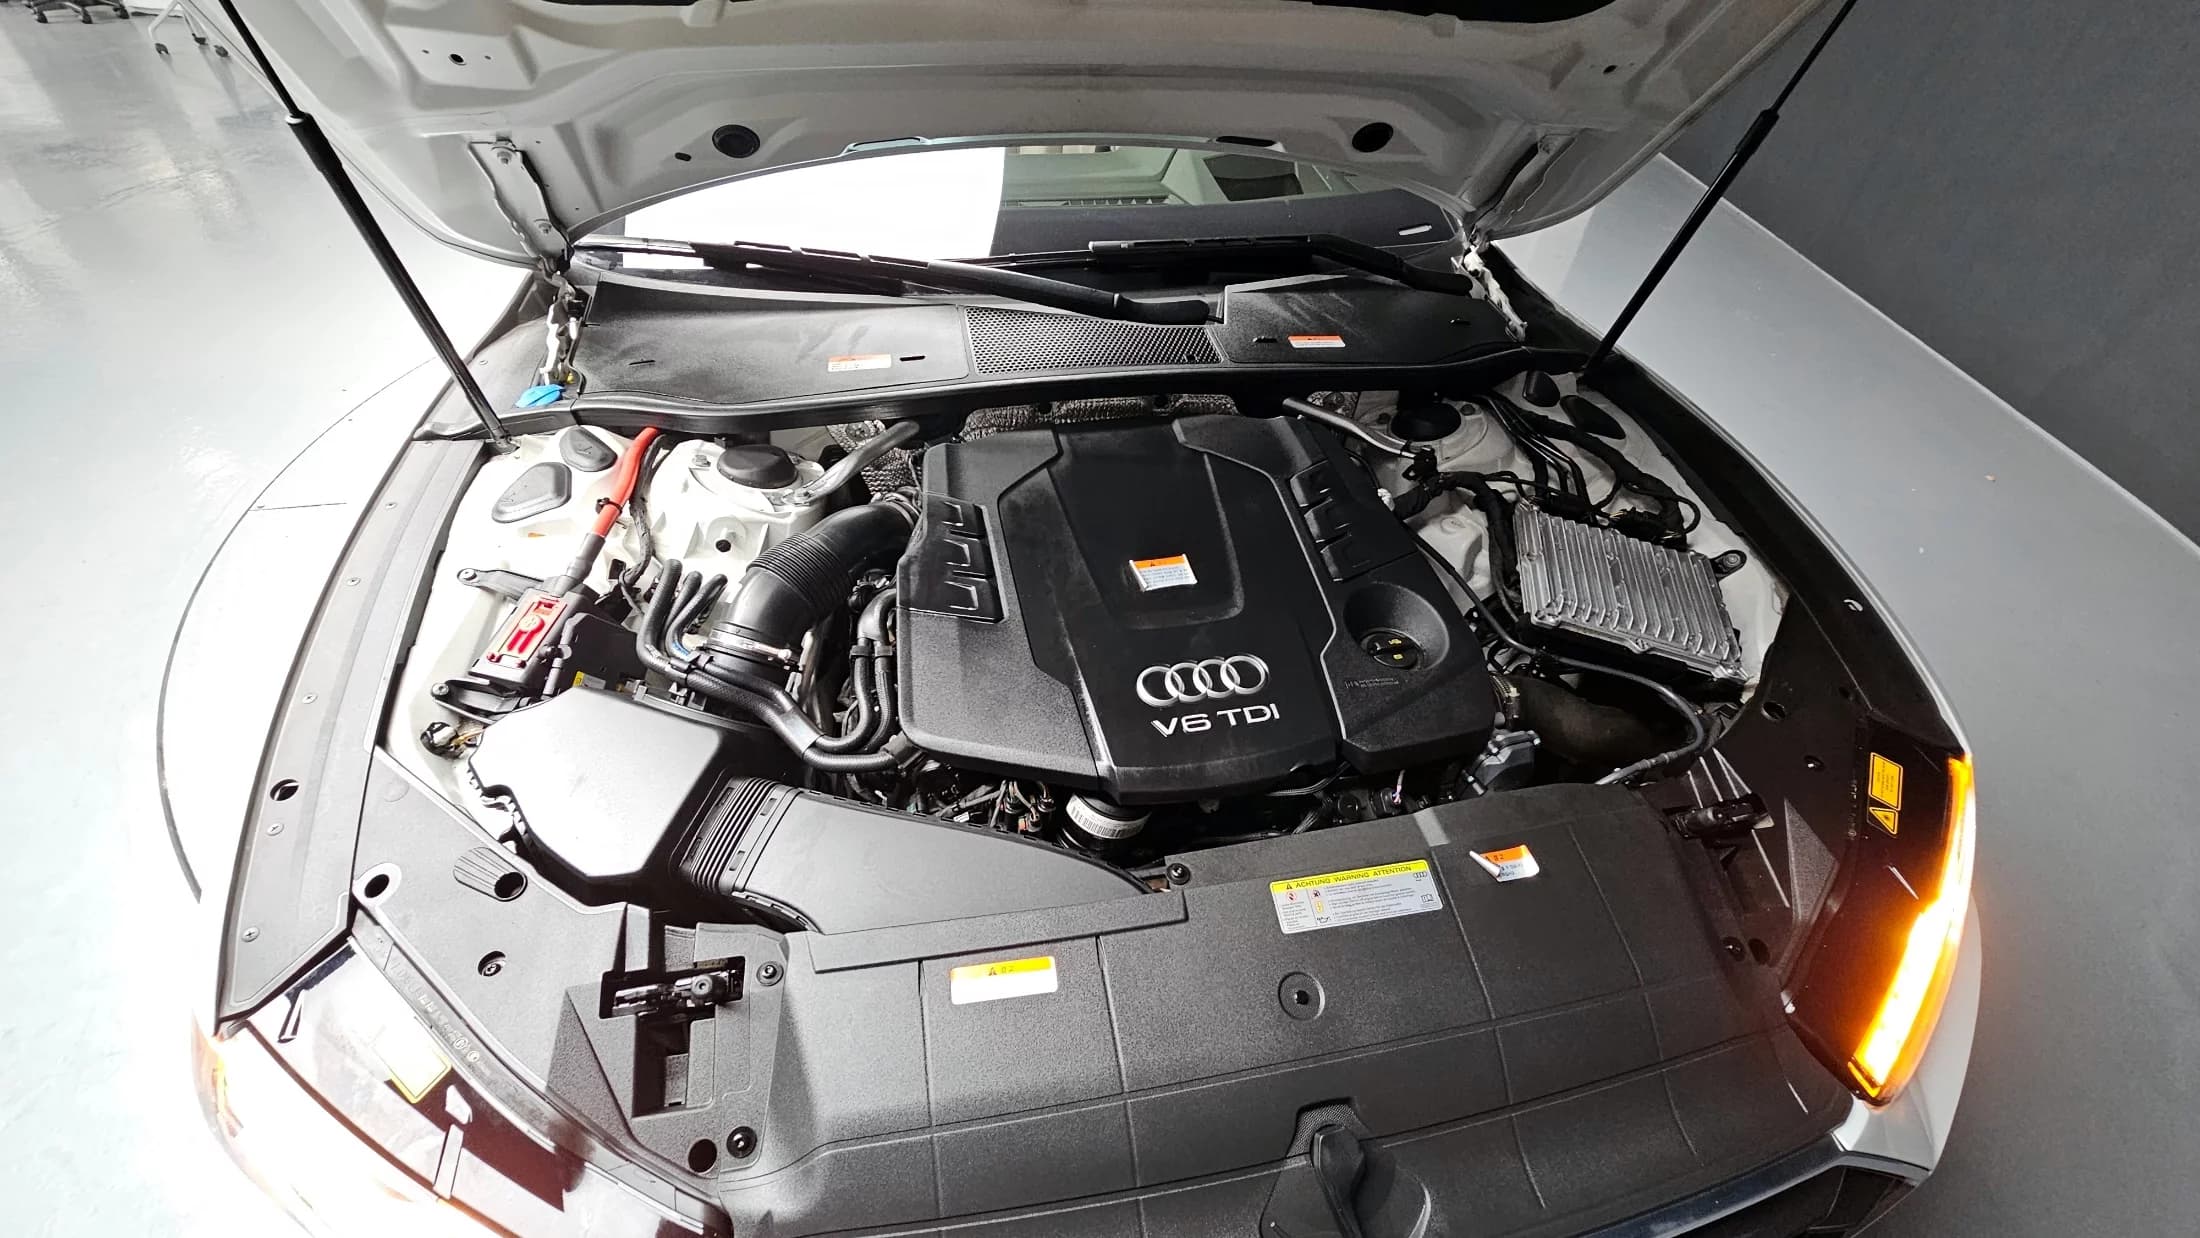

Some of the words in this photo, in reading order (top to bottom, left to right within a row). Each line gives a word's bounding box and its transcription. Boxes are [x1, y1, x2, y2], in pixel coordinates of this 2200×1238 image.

[1151, 713, 1212, 737] V6
[1216, 703, 1280, 727] TDI
[1296, 877, 1331, 888] ACHTUNG
[1335, 871, 1370, 882] WARNING
[1373, 866, 1412, 877] ATTENTION
